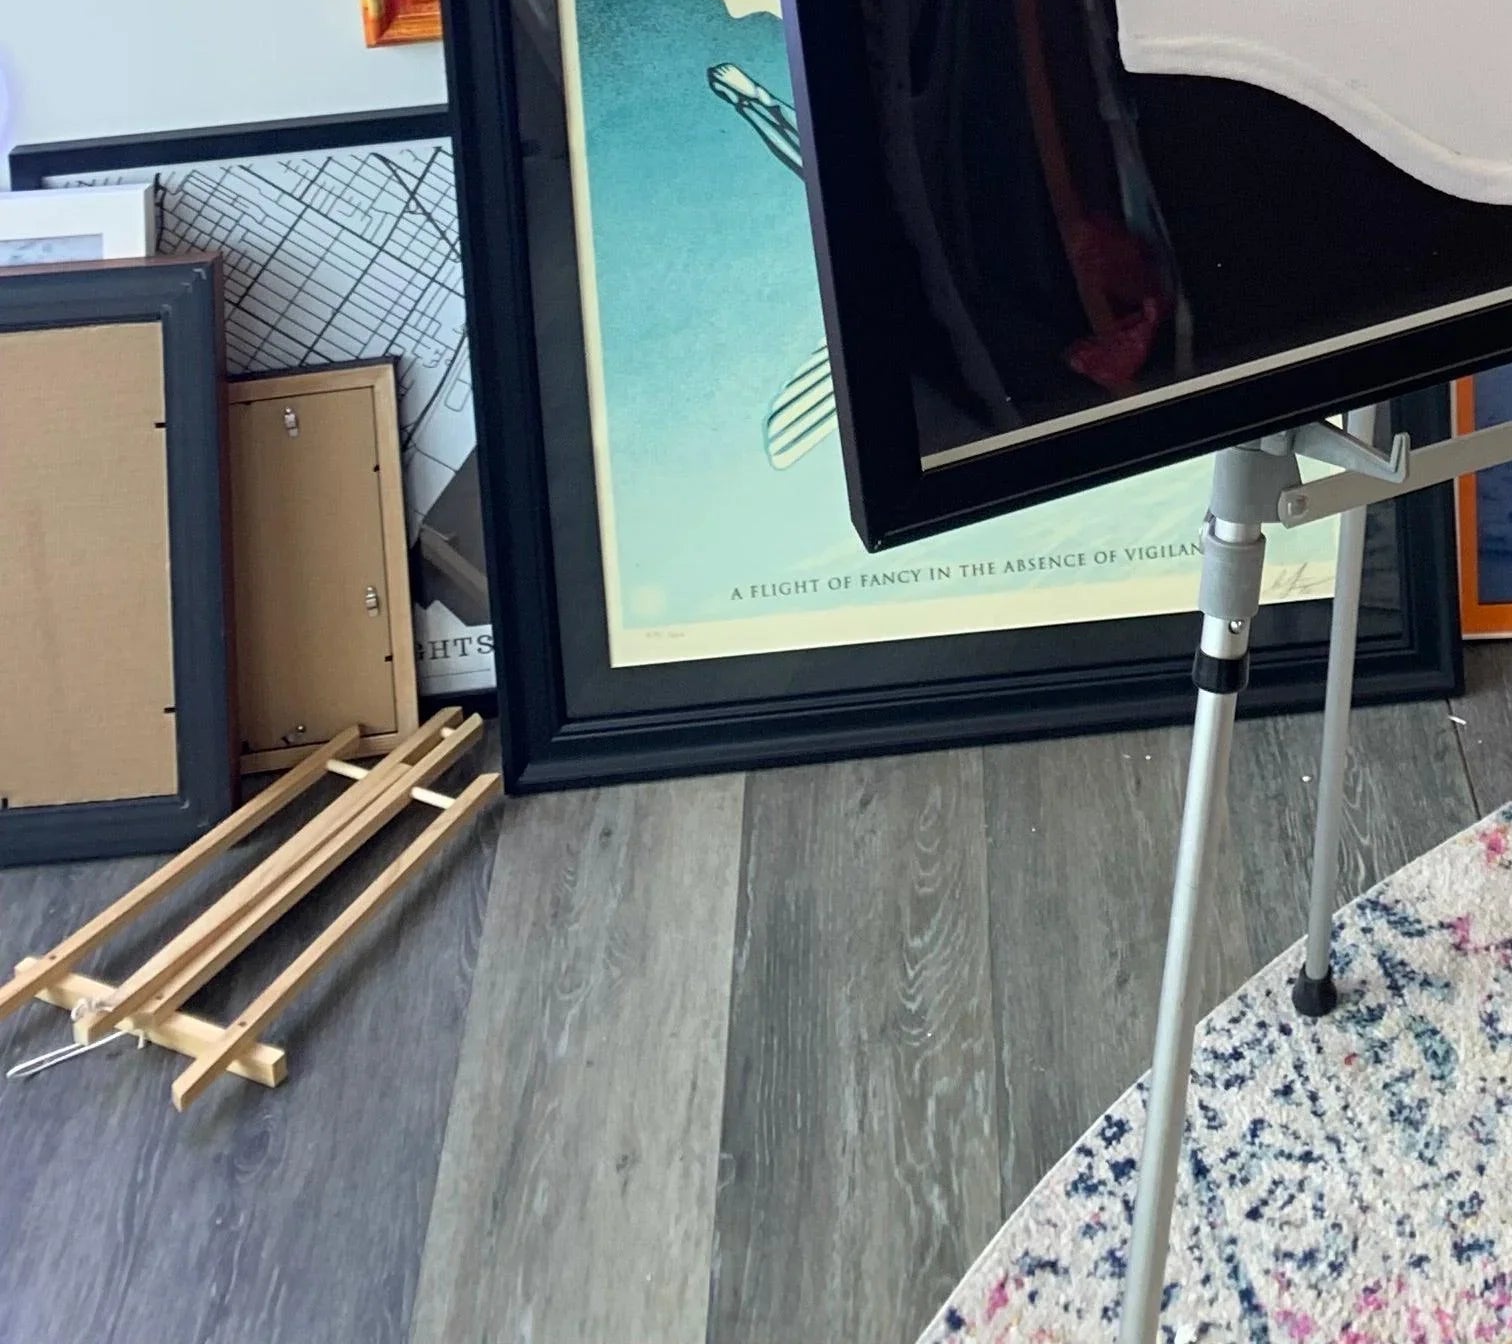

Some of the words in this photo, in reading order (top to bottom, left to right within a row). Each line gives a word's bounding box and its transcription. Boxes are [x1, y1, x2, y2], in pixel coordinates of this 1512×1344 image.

[731, 588, 743, 600] A
[750, 579, 819, 598] FLIGHT
[828, 576, 852, 591] OF
[861, 569, 921, 588] FANCY
[930, 567, 950, 580] IN
[959, 563, 995, 577] THE
[1004, 553, 1087, 573] ABSENCE
[1094, 550, 1117, 564] OF
